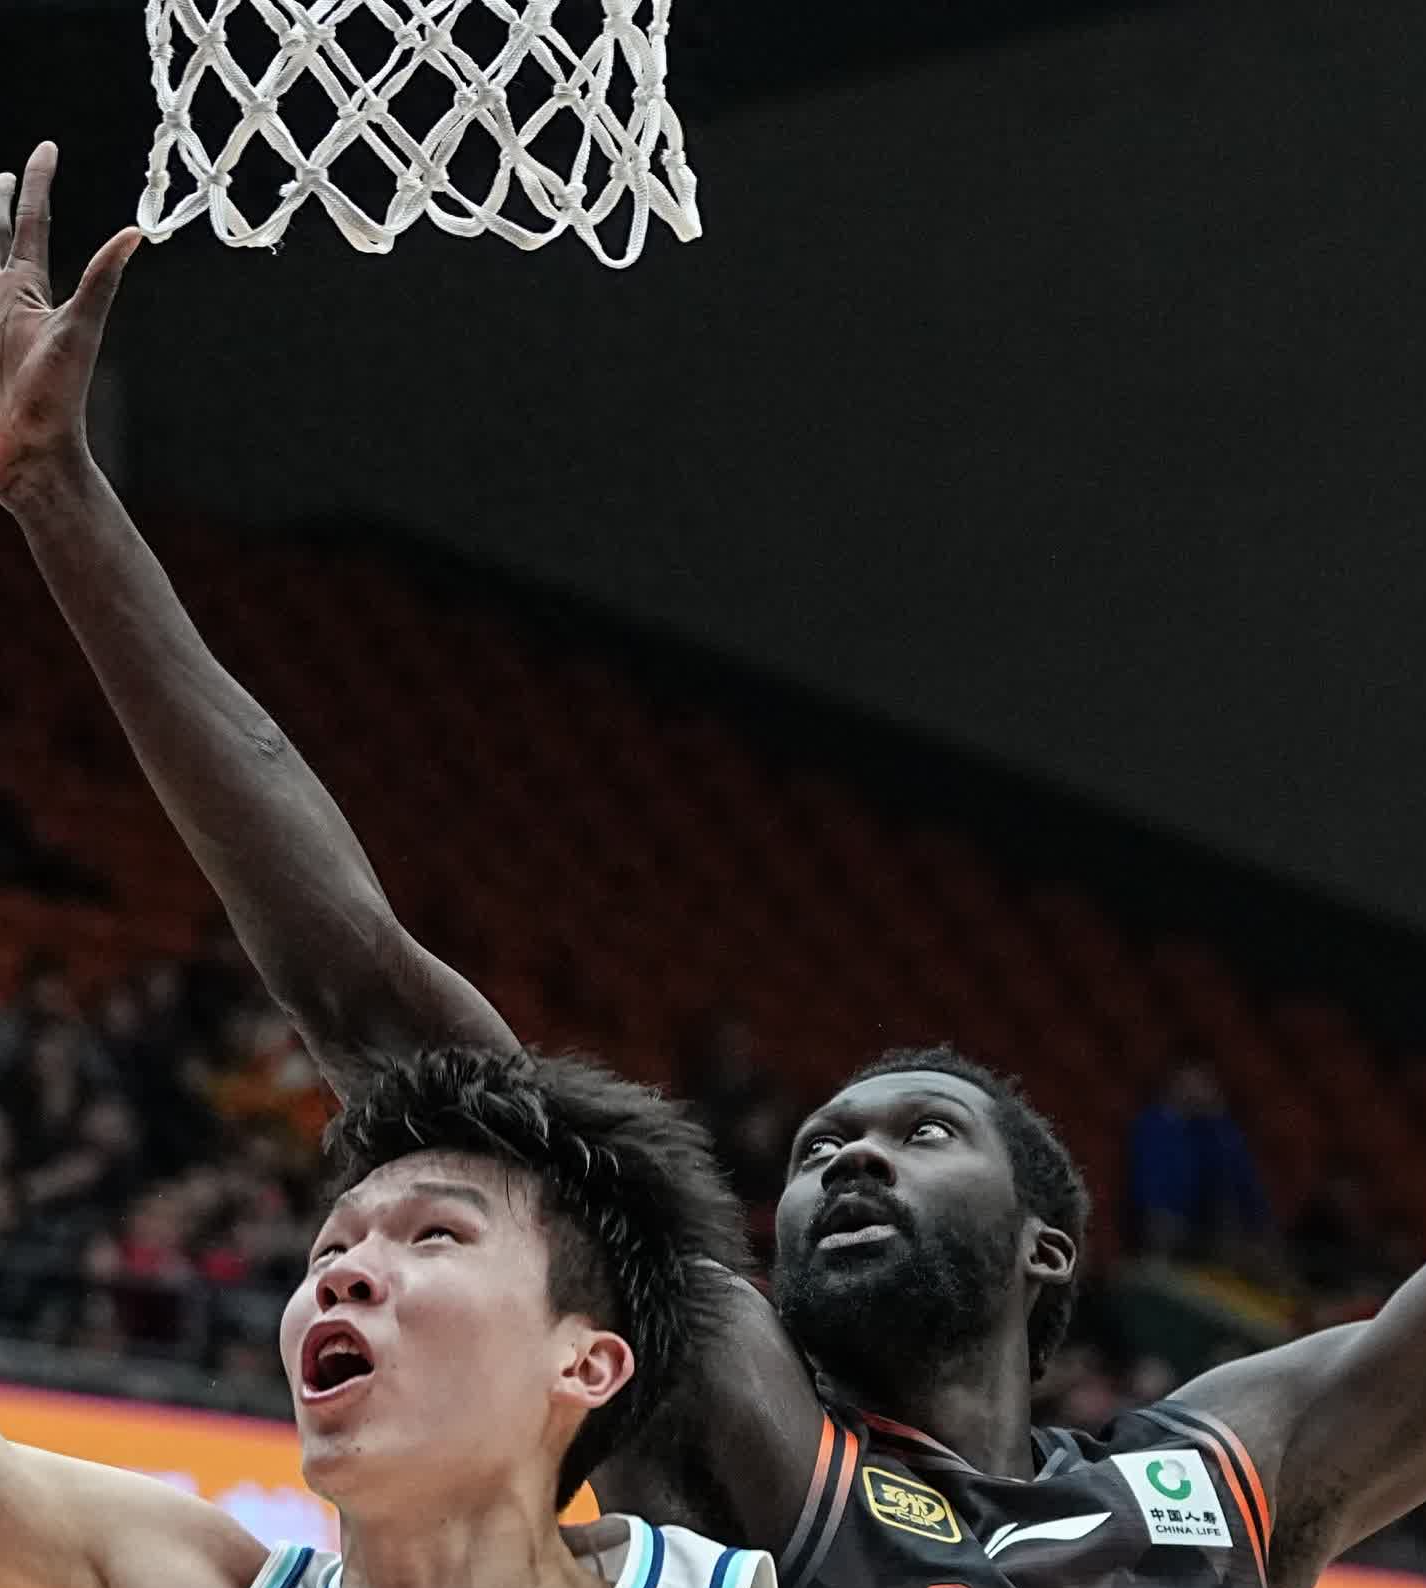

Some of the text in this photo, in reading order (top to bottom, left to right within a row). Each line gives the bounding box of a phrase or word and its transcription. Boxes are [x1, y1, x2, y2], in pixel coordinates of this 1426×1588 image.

[1150, 1507, 1217, 1525] 中国人寿
[1155, 1524, 1222, 1537] CHINA LIFE
